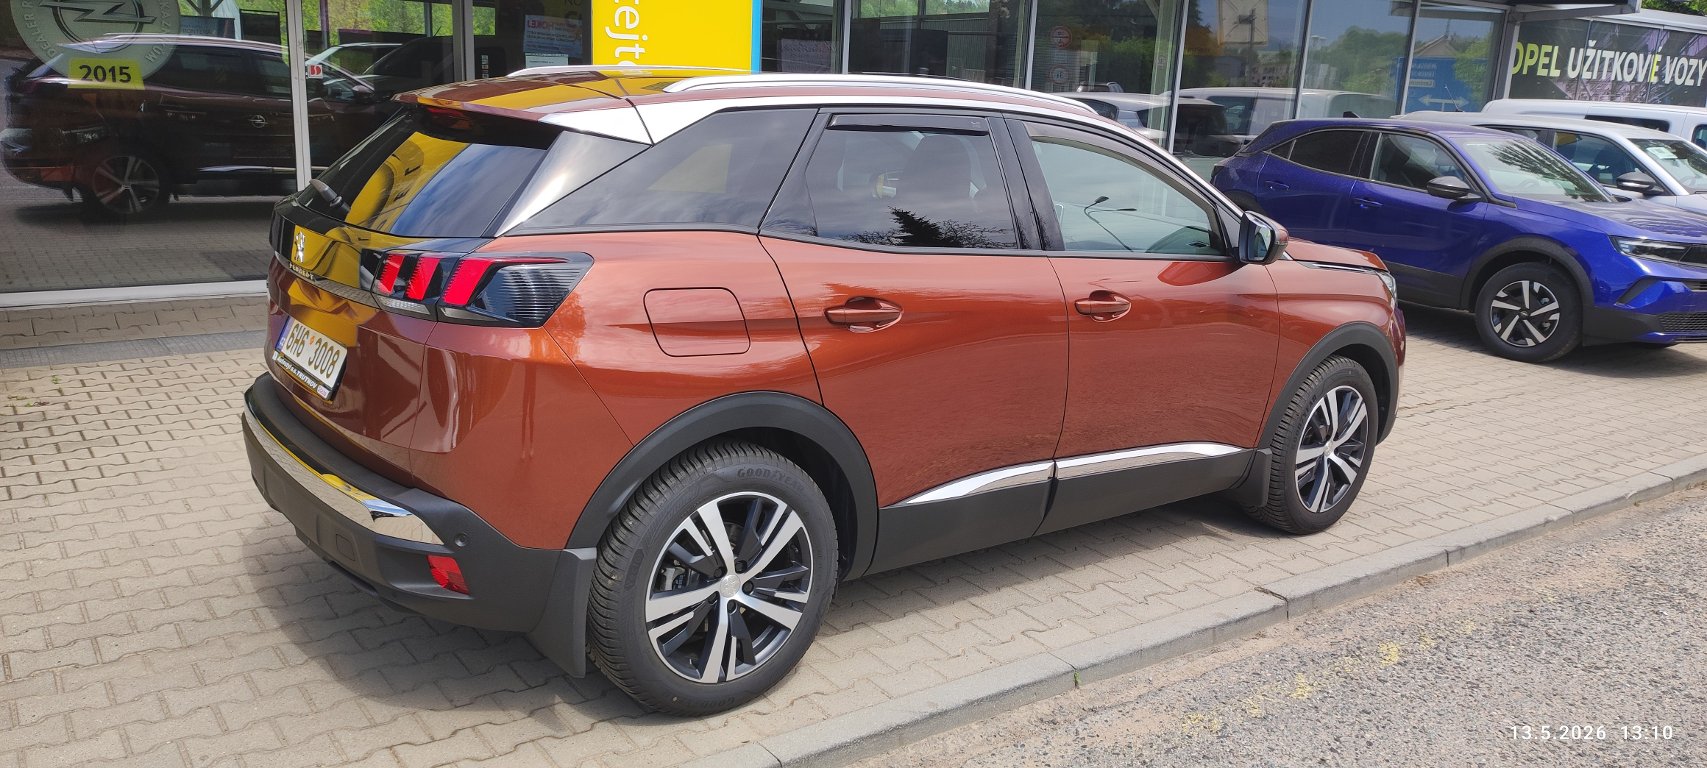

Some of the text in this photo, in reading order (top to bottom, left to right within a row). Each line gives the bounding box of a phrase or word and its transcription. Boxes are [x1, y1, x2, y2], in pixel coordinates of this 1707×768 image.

[23, 12, 57, 59] DEALER
[605, 0, 648, 66] ejt
[79, 64, 131, 83] 2015
[1507, 39, 1707, 87] OPEL UŽITKOVÉ VOZY
[285, 322, 340, 379] 6H6 3008
[737, 468, 805, 492] GOODYEAR
